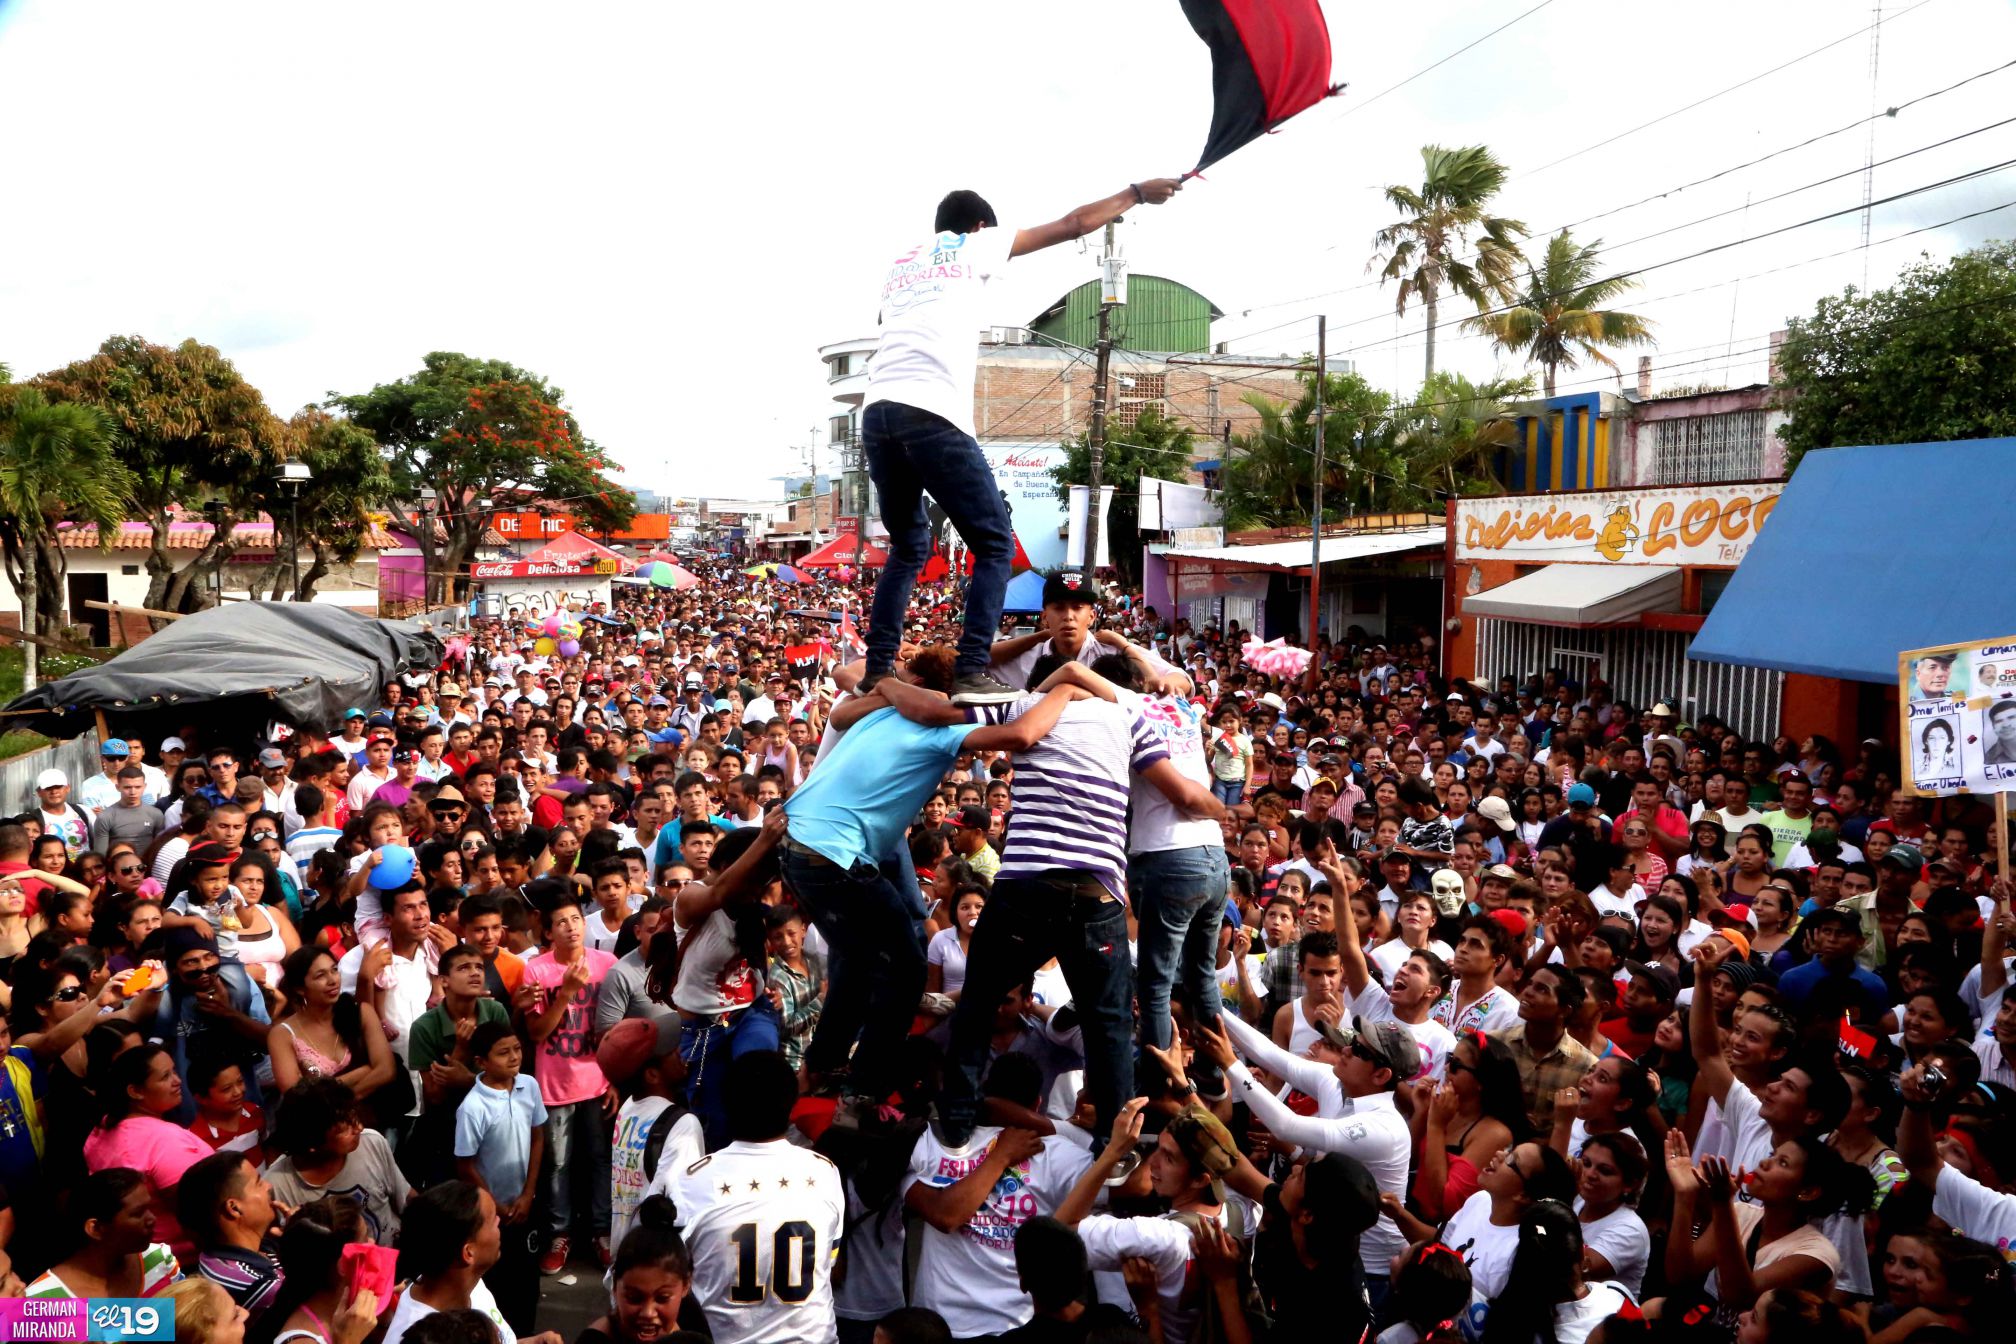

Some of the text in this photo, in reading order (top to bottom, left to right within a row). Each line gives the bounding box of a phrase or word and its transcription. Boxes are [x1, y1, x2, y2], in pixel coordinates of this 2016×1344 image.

[932, 250, 958, 266] EN
[1022, 490, 1059, 500] Esperan
[500, 518, 521, 532] DE
[1465, 503, 1596, 550] Delicias
[1777, 833, 1806, 842] NEVAD
[545, 1030, 599, 1058] SCOR
[729, 1220, 816, 1305] 10
